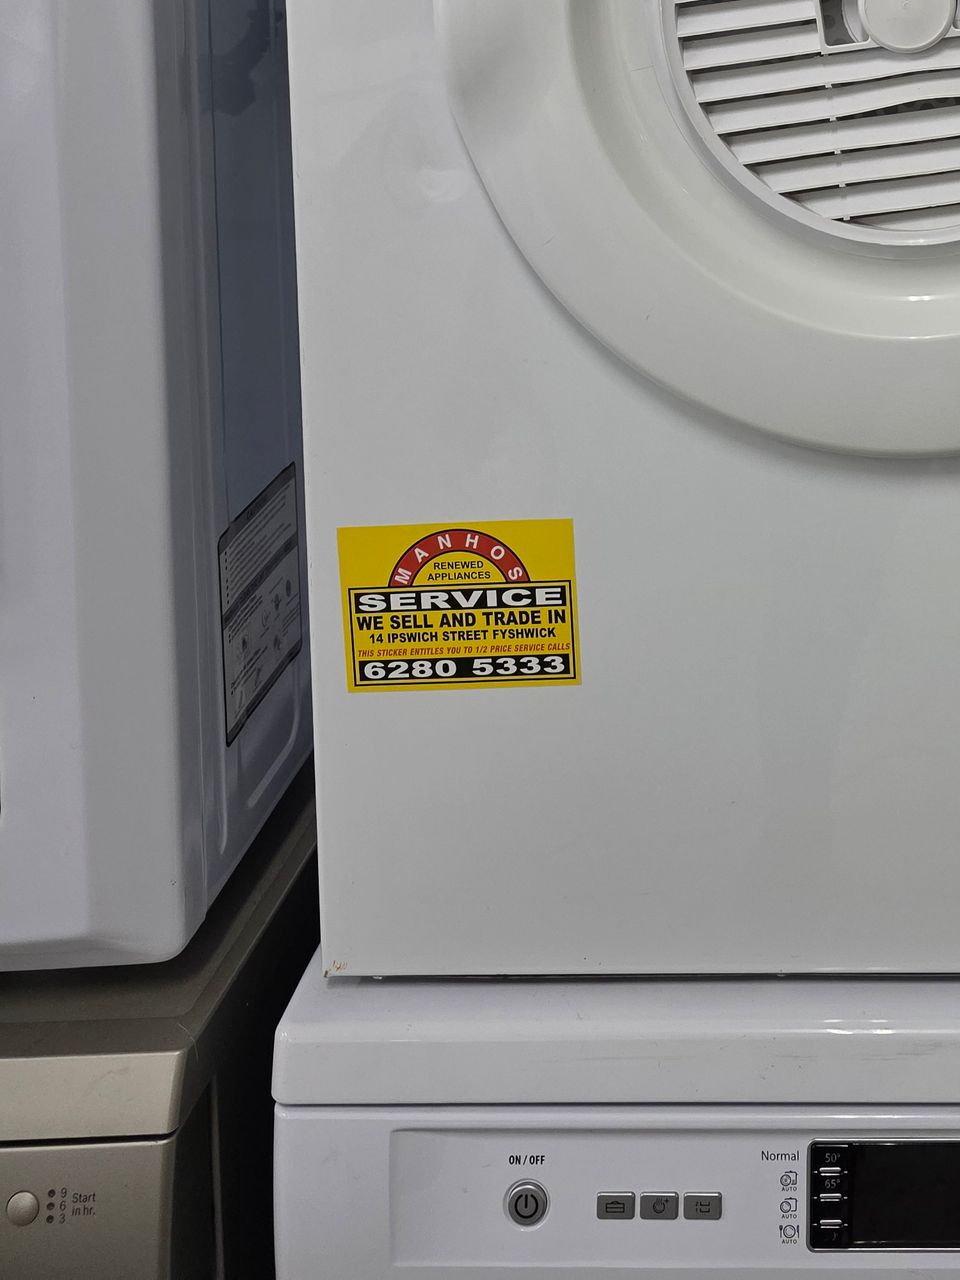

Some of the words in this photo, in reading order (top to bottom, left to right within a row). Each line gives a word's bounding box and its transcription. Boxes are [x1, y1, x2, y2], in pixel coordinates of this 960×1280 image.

[395, 533, 523, 585] MANHOS
[433, 560, 484, 570] RENEWED
[427, 571, 491, 581] APPLIANCES
[358, 588, 563, 612] SERVICE
[356, 616, 384, 631] WE
[390, 615, 433, 630] SELL
[439, 613, 477, 628] AND
[482, 610, 541, 626] TRADE
[548, 609, 566, 624] IN
[369, 633, 384, 644] 14
[388, 631, 438, 643] IPSWICH
[442, 629, 488, 641] STREET
[492, 627, 556, 640] FYSHWICK
[358, 649, 374, 658] THIS
[377, 648, 408, 657] STICKER
[410, 647, 444, 656] ENTITLES
[447, 646, 461, 655] YOU
[463, 645, 473, 654] TO
[475, 645, 488, 654] 1/2
[490, 644, 512, 653] PRICE
[514, 643, 545, 652] SERVICE
[547, 642, 571, 651] CALLS
[364, 659, 457, 679] 6280
[472, 655, 565, 676] 5333
[509, 1154, 521, 1165] ON
[529, 1154, 545, 1165] OFF
[761, 1150, 799, 1162] Normal
[60, 1187, 67, 1198] 9
[72, 1192, 95, 1203] Start
[60, 1200, 66, 1211] 6
[72, 1206, 81, 1216] in
[83, 1205, 95, 1216] hr.
[59, 1213, 66, 1224] 3
